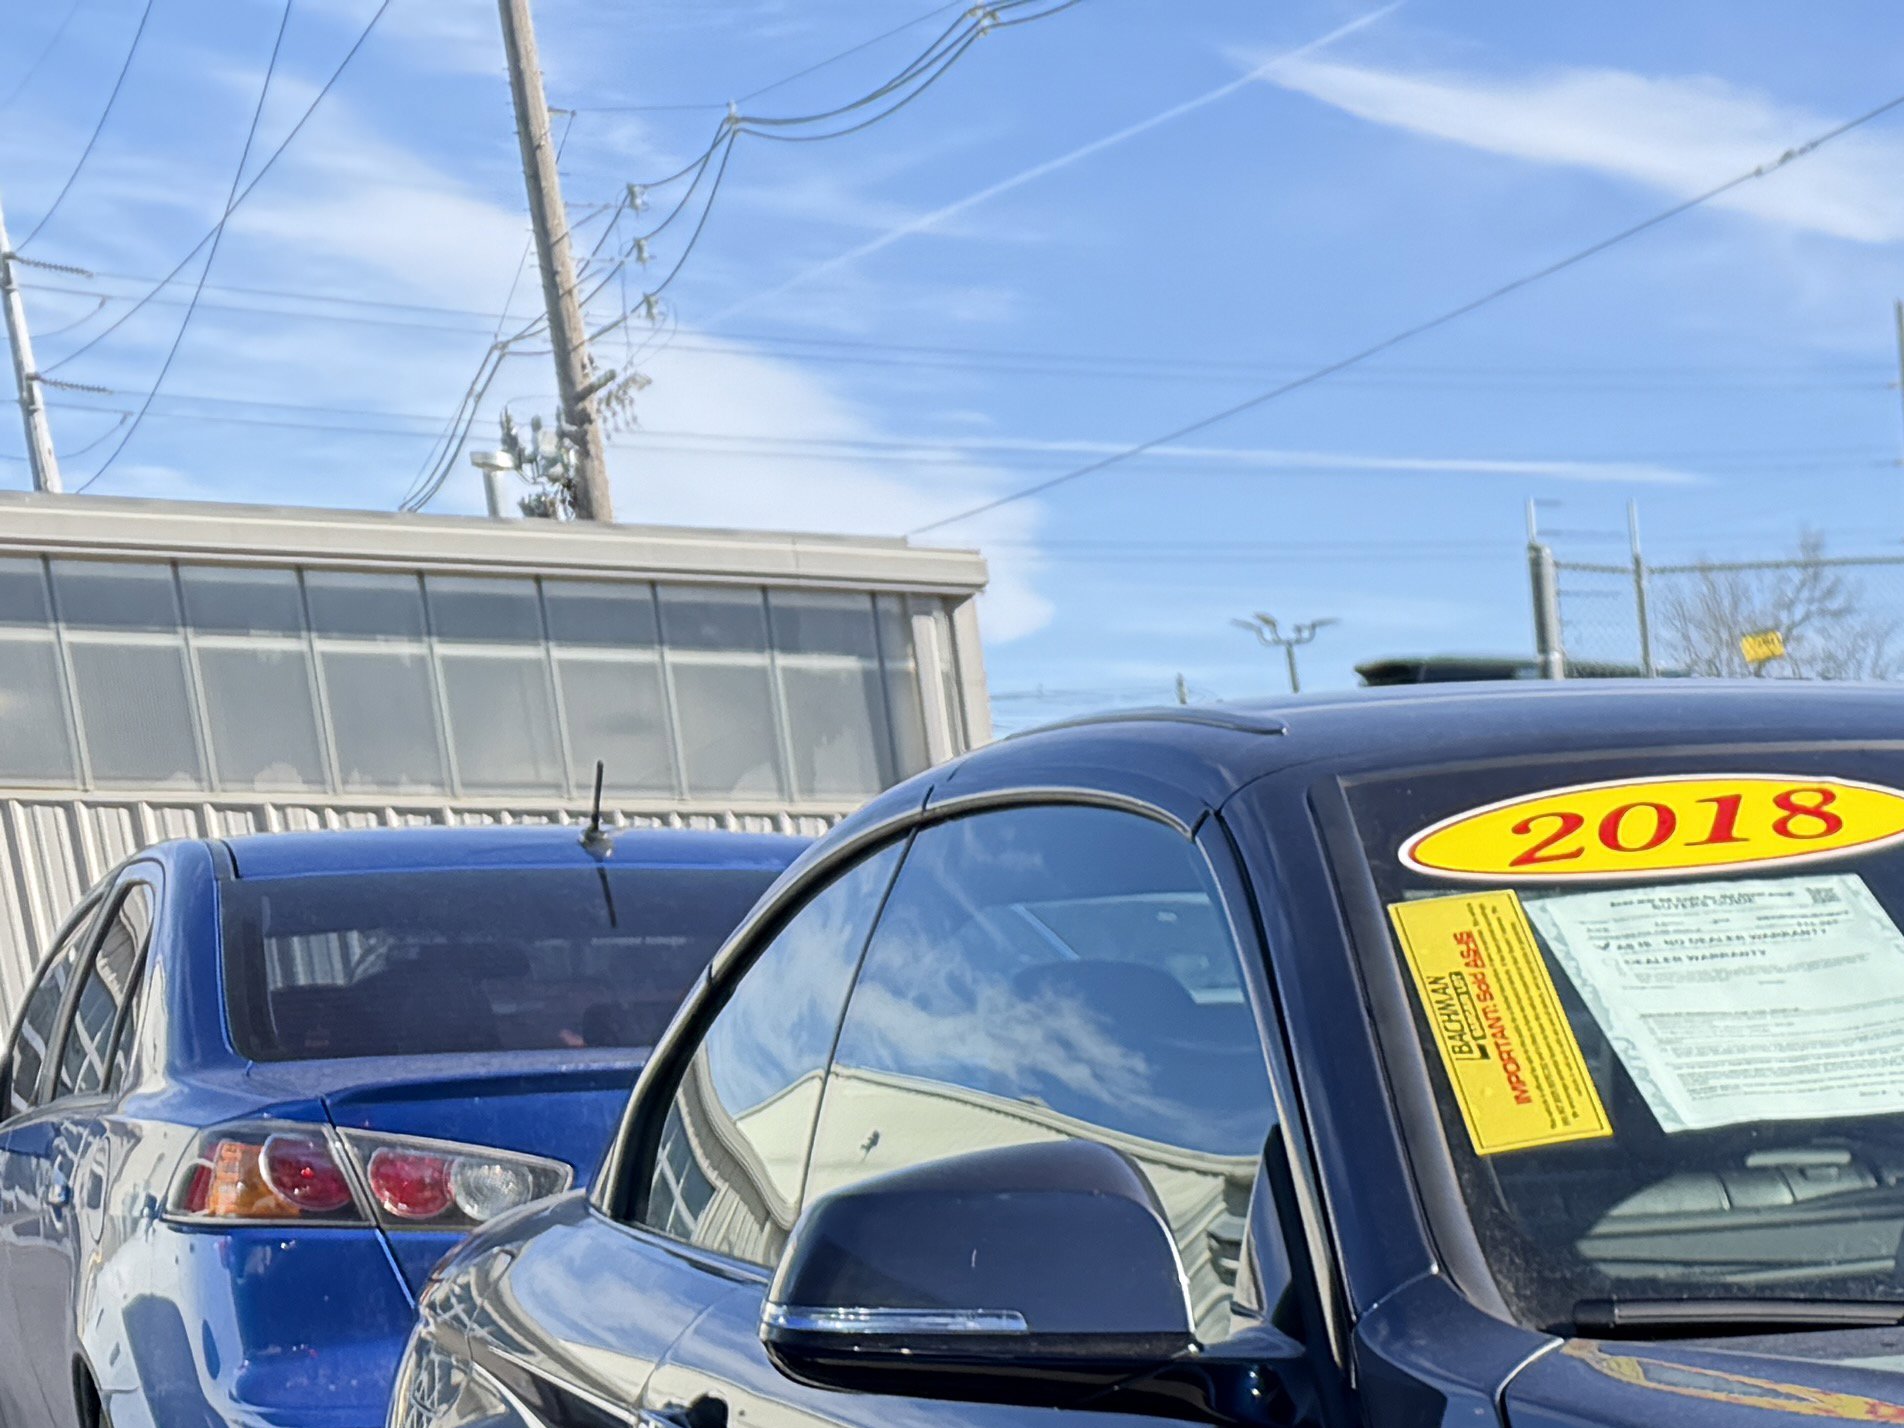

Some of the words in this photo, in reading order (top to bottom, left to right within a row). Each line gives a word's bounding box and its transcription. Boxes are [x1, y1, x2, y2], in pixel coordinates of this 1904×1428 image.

[1509, 786, 1843, 868] 2018
[1427, 975, 1474, 1055] BACHMAN
[1468, 971, 1495, 1002] Sold
[1482, 1003, 1533, 1105] IMPORTANT:
